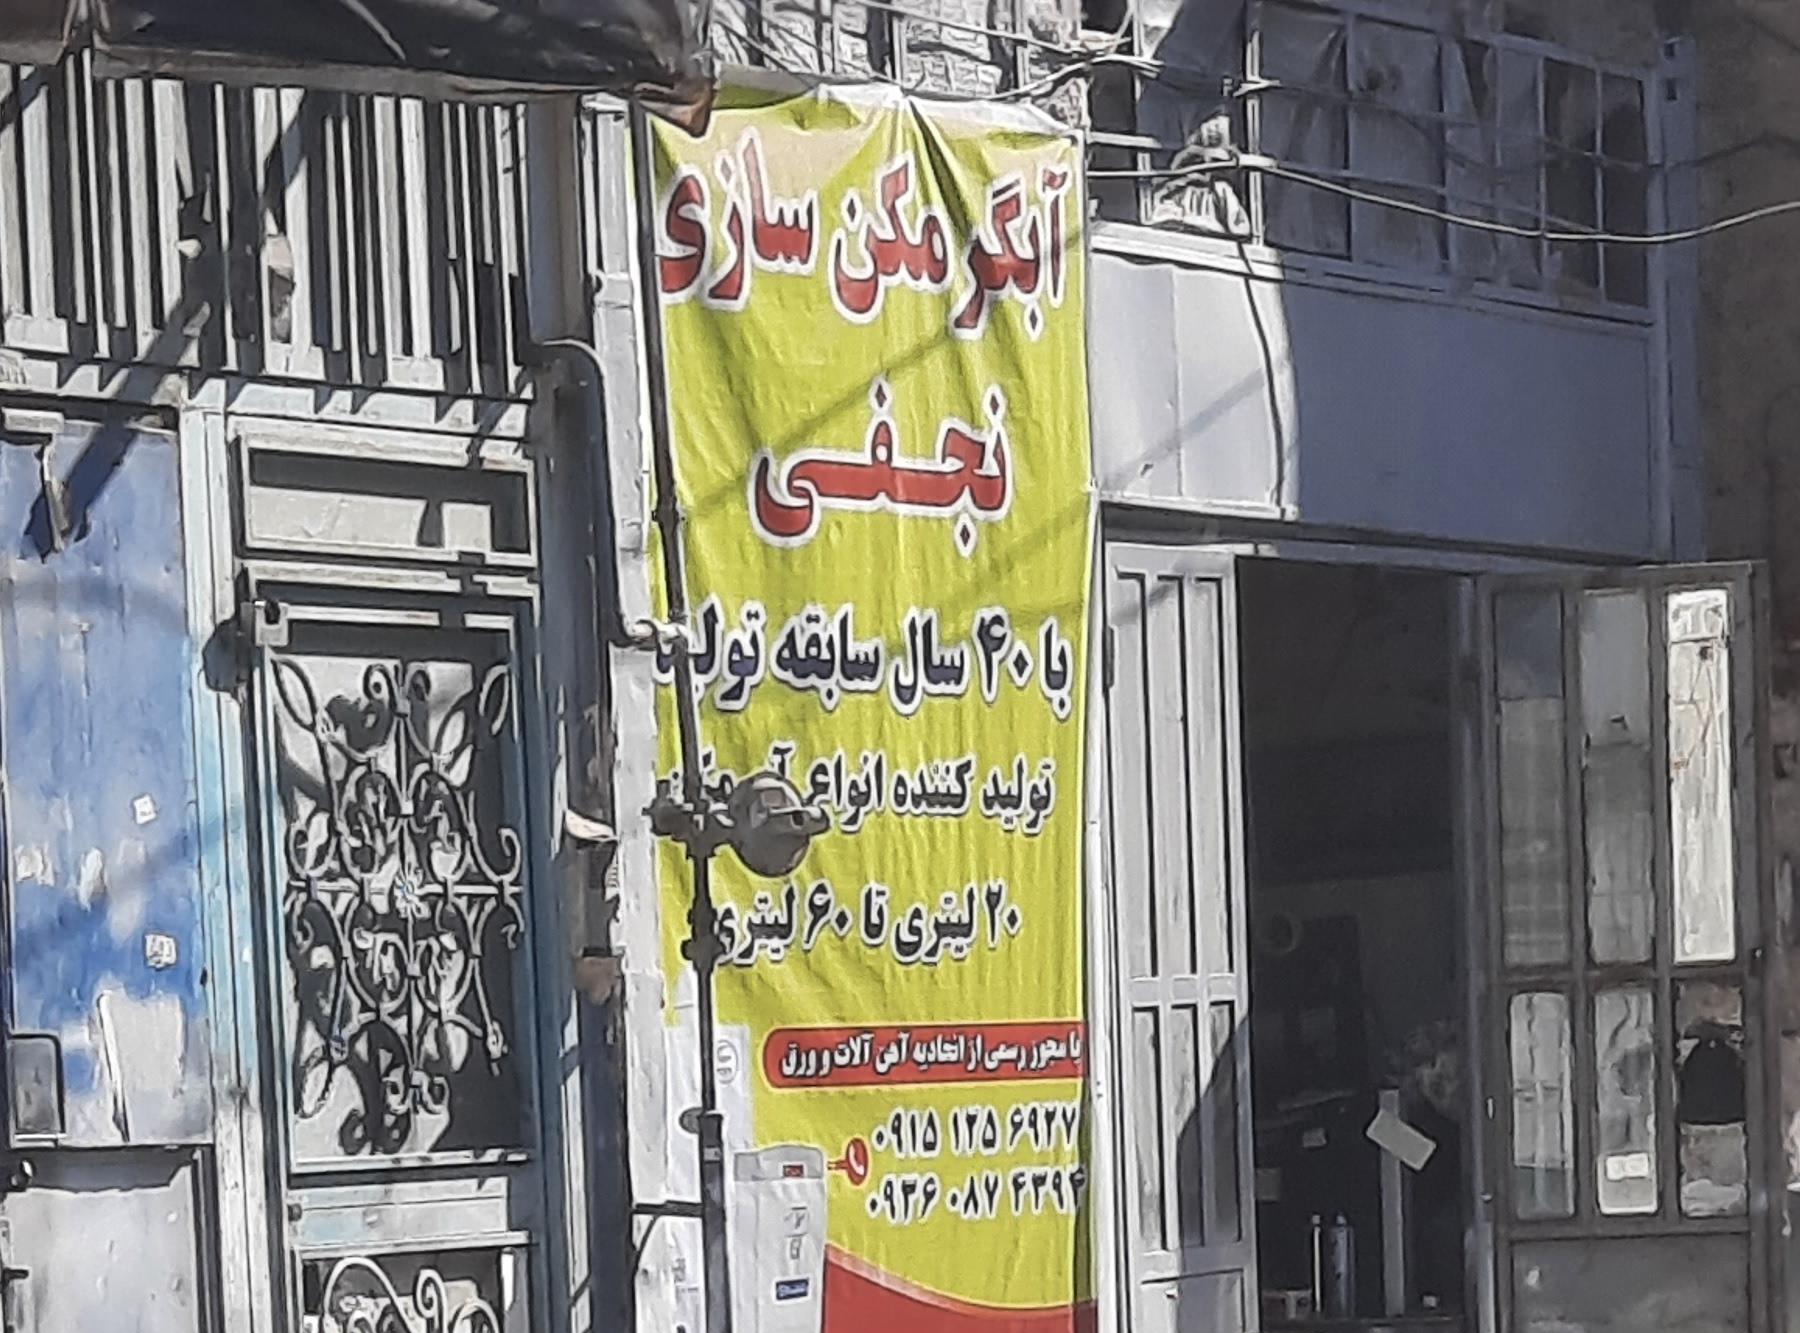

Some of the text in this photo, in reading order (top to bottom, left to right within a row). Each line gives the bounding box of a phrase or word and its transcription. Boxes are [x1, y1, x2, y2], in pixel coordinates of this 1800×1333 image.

[658, 134, 814, 302] سازی
[754, 378, 1010, 550] نجفی
[655, 602, 1073, 713] با ۴۰ سال سابقه تول
[804, 749, 884, 828] انواع
[892, 757, 974, 812] کننده
[981, 757, 1055, 830] تولید
[803, 881, 850, 946] ۶۰
[864, 884, 890, 942] تا
[894, 884, 976, 960] لیتری
[984, 883, 1020, 945] ۲۰
[780, 1042, 817, 1077] ورق
[818, 1048, 831, 1077] و
[833, 1031, 875, 1067] آلات
[875, 1030, 911, 1075] آهن
[911, 1033, 966, 1071] اتحادیه
[966, 1033, 983, 1072] از
[983, 1042, 1027, 1072] رسمی
[874, 1104, 1078, 1155] ۰۹۱۵ ۱۲۵ ۶۹۲۷
[867, 1165, 1087, 1222] ۰۹۳۶ ۰۸۷ ۴۳۹۴
